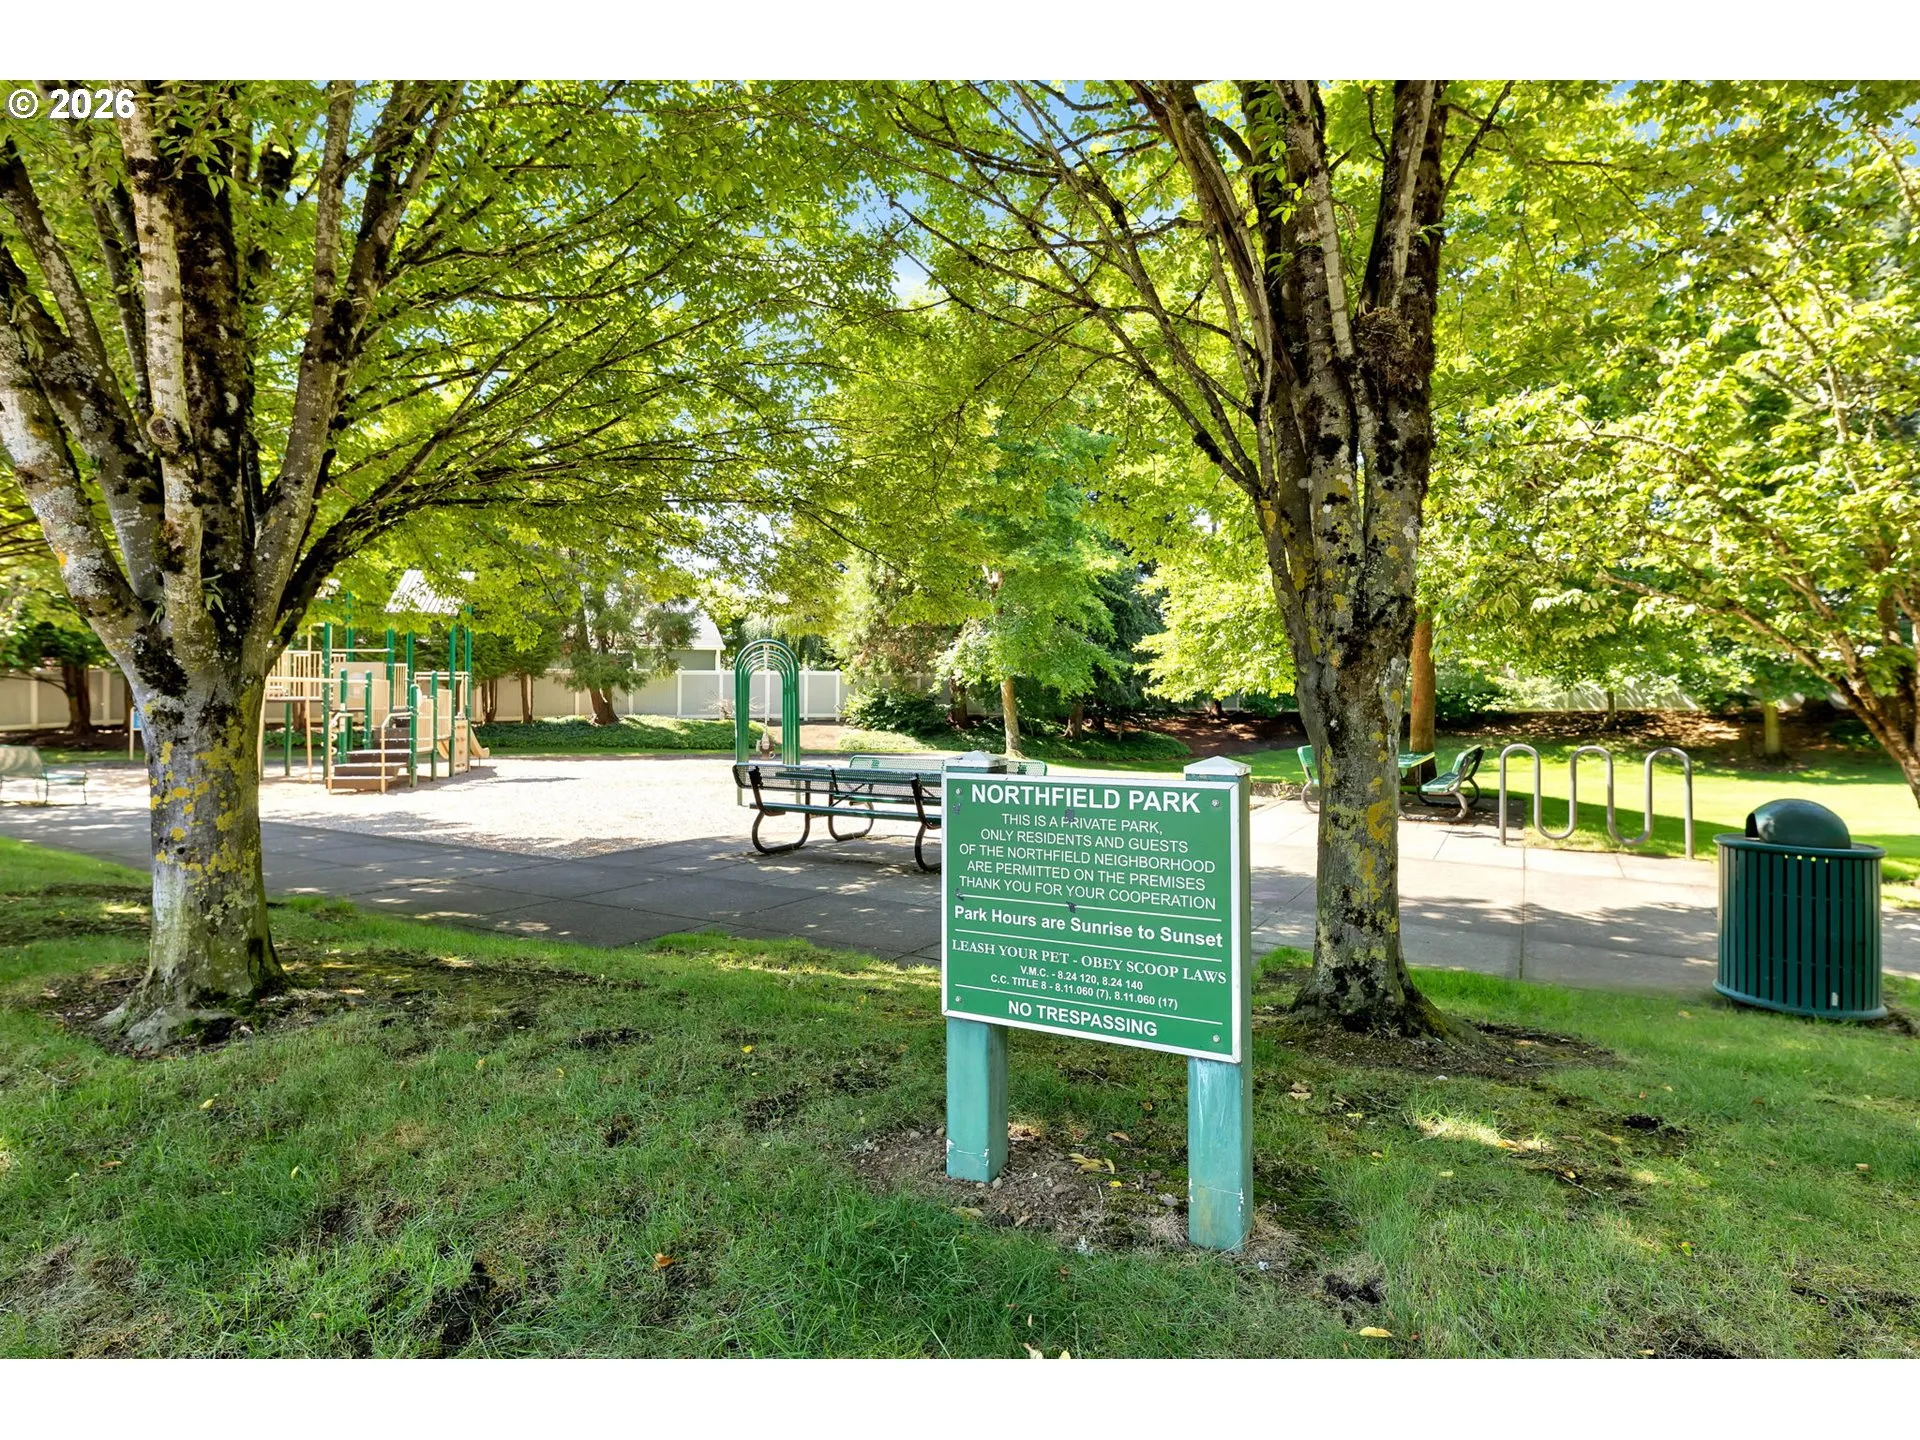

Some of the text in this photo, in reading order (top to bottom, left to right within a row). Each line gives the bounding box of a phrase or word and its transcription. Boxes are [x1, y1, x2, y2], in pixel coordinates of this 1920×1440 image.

[971, 784, 1200, 813] NORTHFIELD PARK
[1002, 813, 1163, 834] THIS IS A PRIVATE PARK,
[981, 829, 1188, 853] ONLY RESIDENTS AND GUESTS
[959, 844, 1215, 874] OF THE NORTHFIELD NEIGHBORHOOD
[967, 860, 1205, 891] ARE PERMITTED ON THE PREMISES
[959, 876, 1215, 910] THANK YOU FOR YOUR COOPERATION
[954, 905, 1223, 947] Park Hours are Sunrise to Sunset
[952, 939, 994, 954] LEASH
[999, 945, 1038, 960] YOUR
[1041, 952, 1069, 964] PET
[1081, 955, 1123, 971] OBEY
[1126, 961, 1179, 978] SCOOP
[1182, 968, 1226, 985] LAWS
[991, 974, 1009, 985] C.C.
[1012, 977, 1038, 989] TITLE
[1041, 981, 1047, 990] 8
[1055, 983, 1093, 996] 8.11.060
[1096, 988, 1111, 1001] (7),
[1114, 991, 1155, 1005] 8.11.060
[1158, 997, 1178, 1010] (17)
[1020, 966, 1049, 978] V.M.C.
[1058, 971, 1077, 981] 8.24
[1080, 973, 1099, 985] 120,
[1102, 976, 1122, 987] 8.24
[1125, 979, 1143, 990] 140
[1008, 1001, 1157, 1036] NO TRESPASSING
